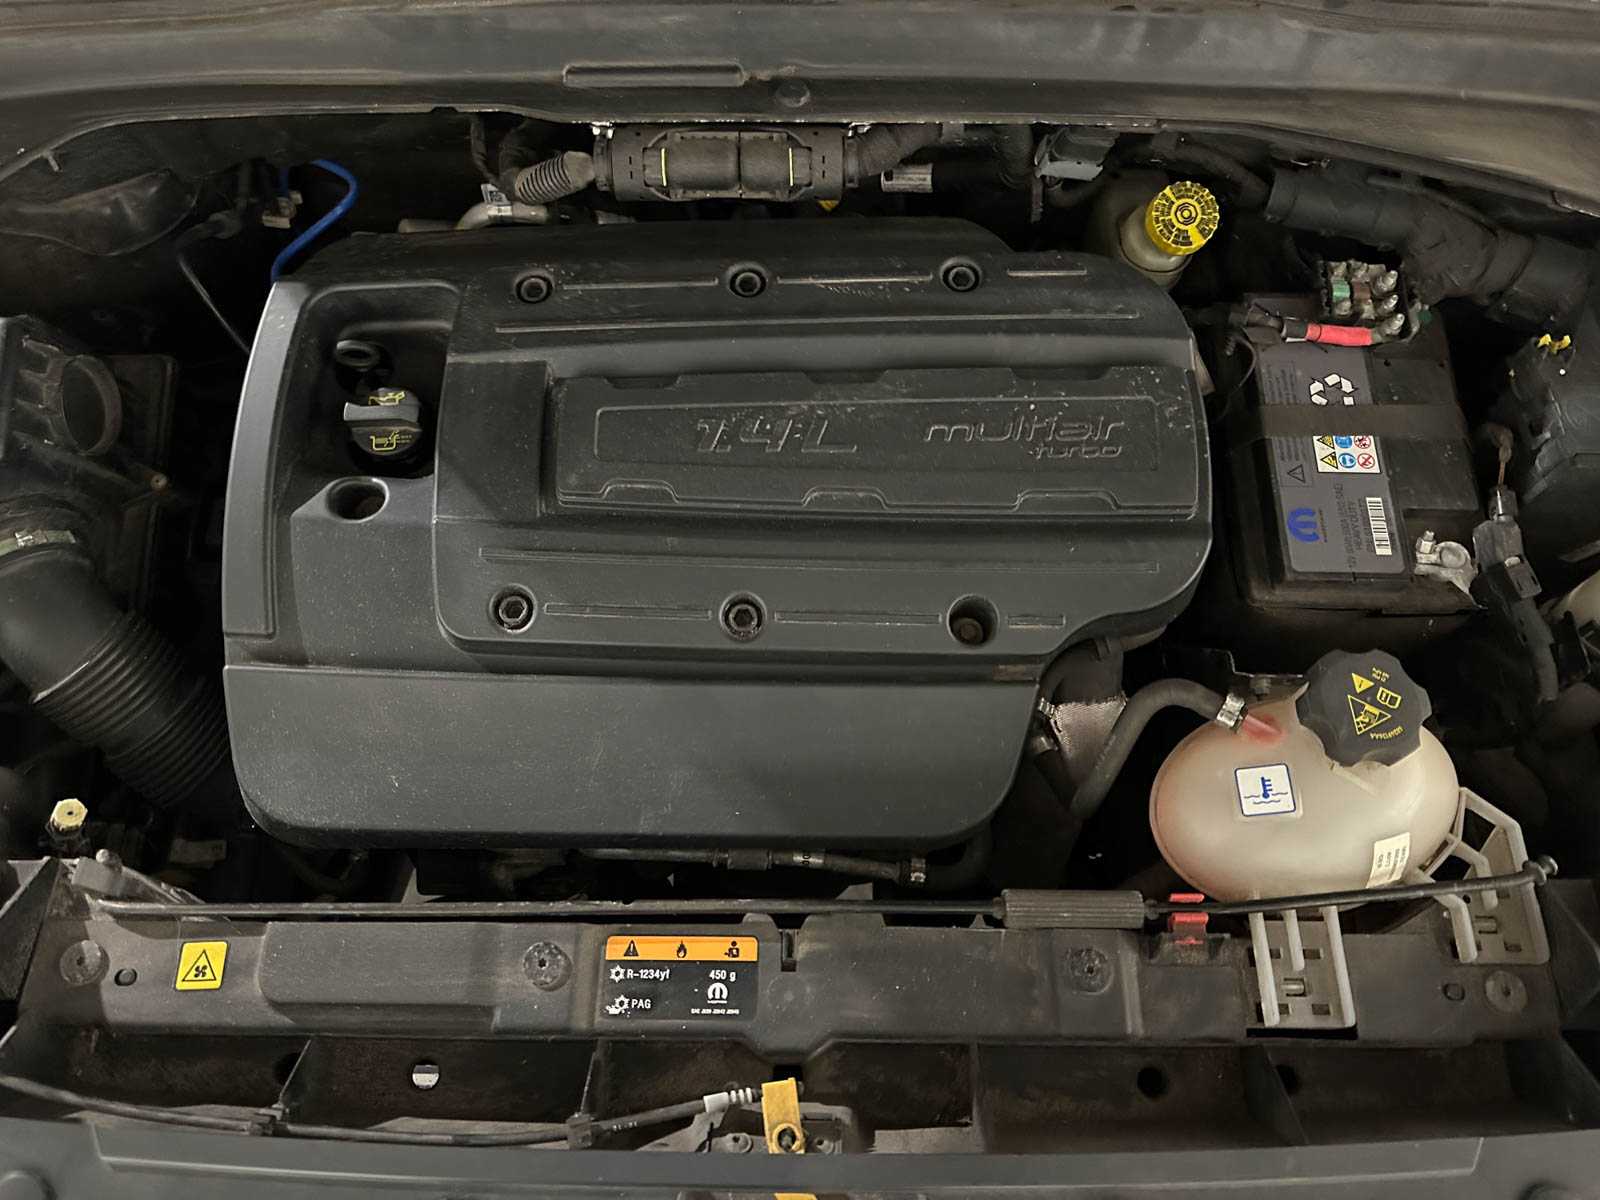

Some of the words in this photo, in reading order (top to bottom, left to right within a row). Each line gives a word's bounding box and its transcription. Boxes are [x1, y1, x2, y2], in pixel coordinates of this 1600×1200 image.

[925, 415, 1125, 442] multiair
[626, 968, 670, 981] R-1234yf
[709, 969, 727, 980] 450
[729, 971, 736, 982] g
[631, 999, 652, 1009] PAG
